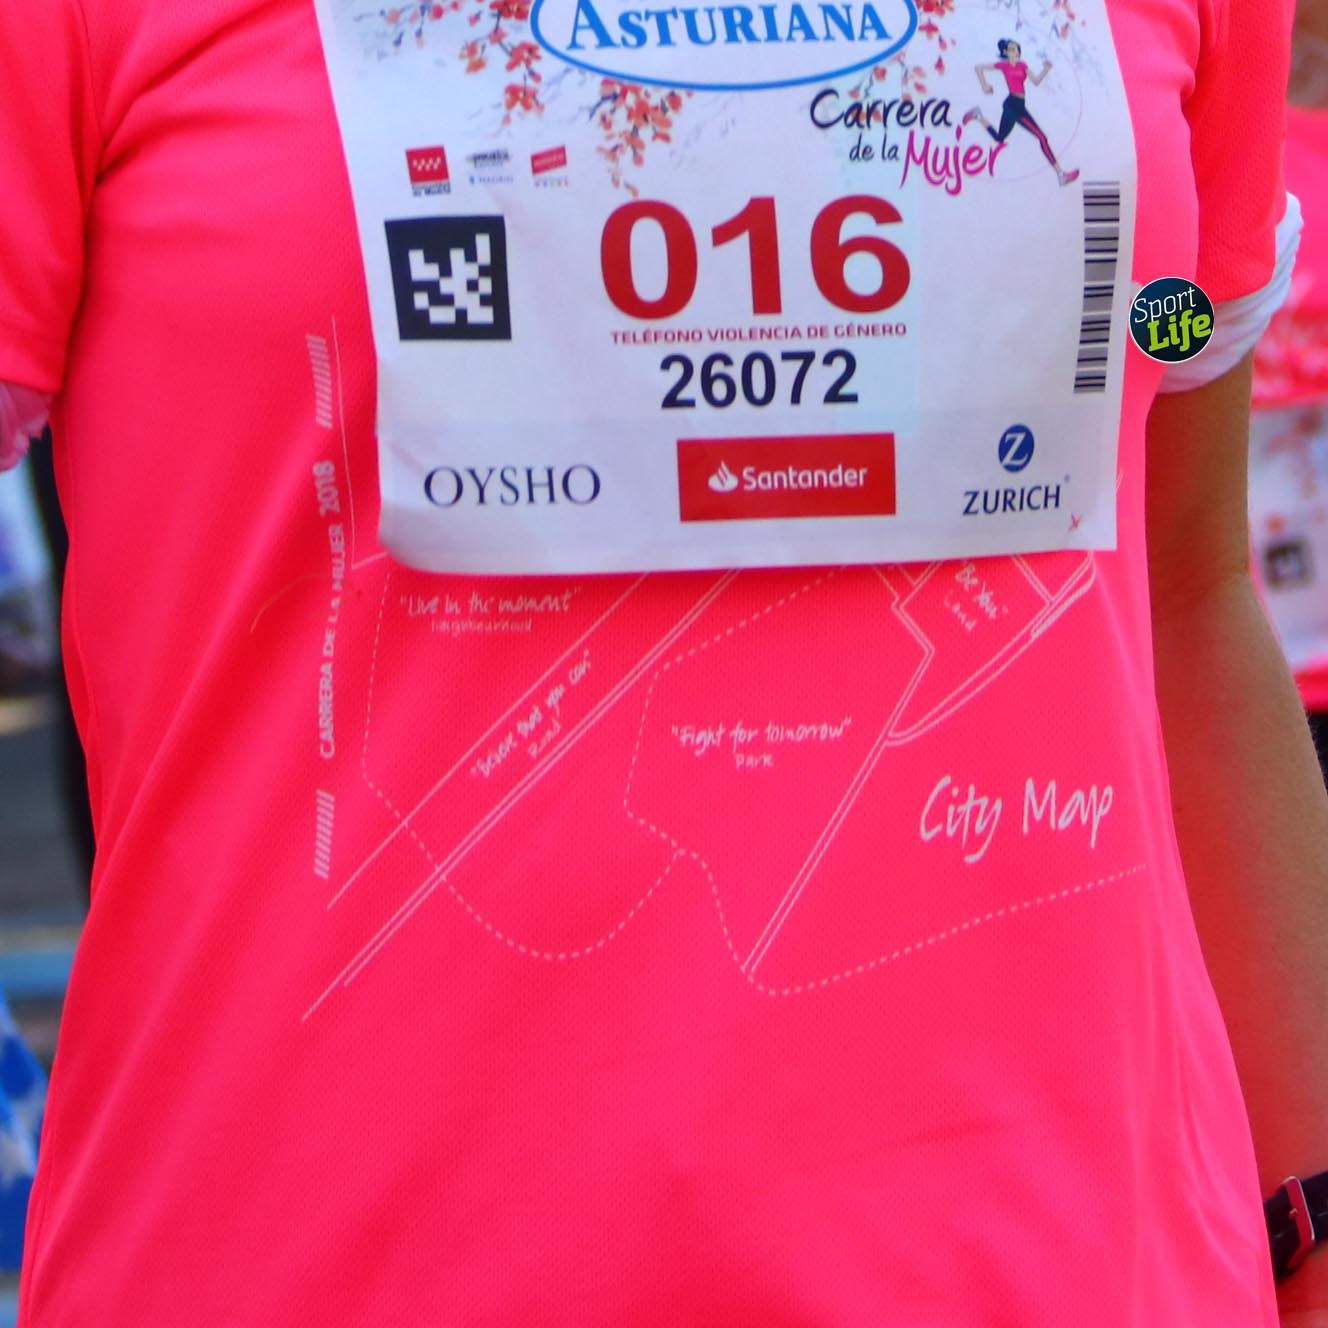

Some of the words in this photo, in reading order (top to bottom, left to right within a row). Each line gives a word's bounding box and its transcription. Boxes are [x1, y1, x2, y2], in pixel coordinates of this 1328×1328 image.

[809, 88, 953, 130] Carrera
[848, 132, 875, 163] de
[880, 133, 900, 162] la
[900, 124, 1008, 196] Mujer
[600, 193, 911, 320] 016
[610, 327, 704, 346] TELÉFONO
[707, 325, 803, 342] VIOLENCIA
[807, 325, 830, 340] DE
[833, 321, 908, 339] GÉNERO
[659, 348, 860, 410] 26072
[312, 459, 341, 517] 2018
[424, 463, 602, 508] OYSHO
[742, 463, 869, 492] Santander
[962, 484, 1062, 517] ZURICH
[318, 662, 336, 760] CARRERA
[919, 774, 1003, 864] City
[1022, 777, 1114, 849] Map
